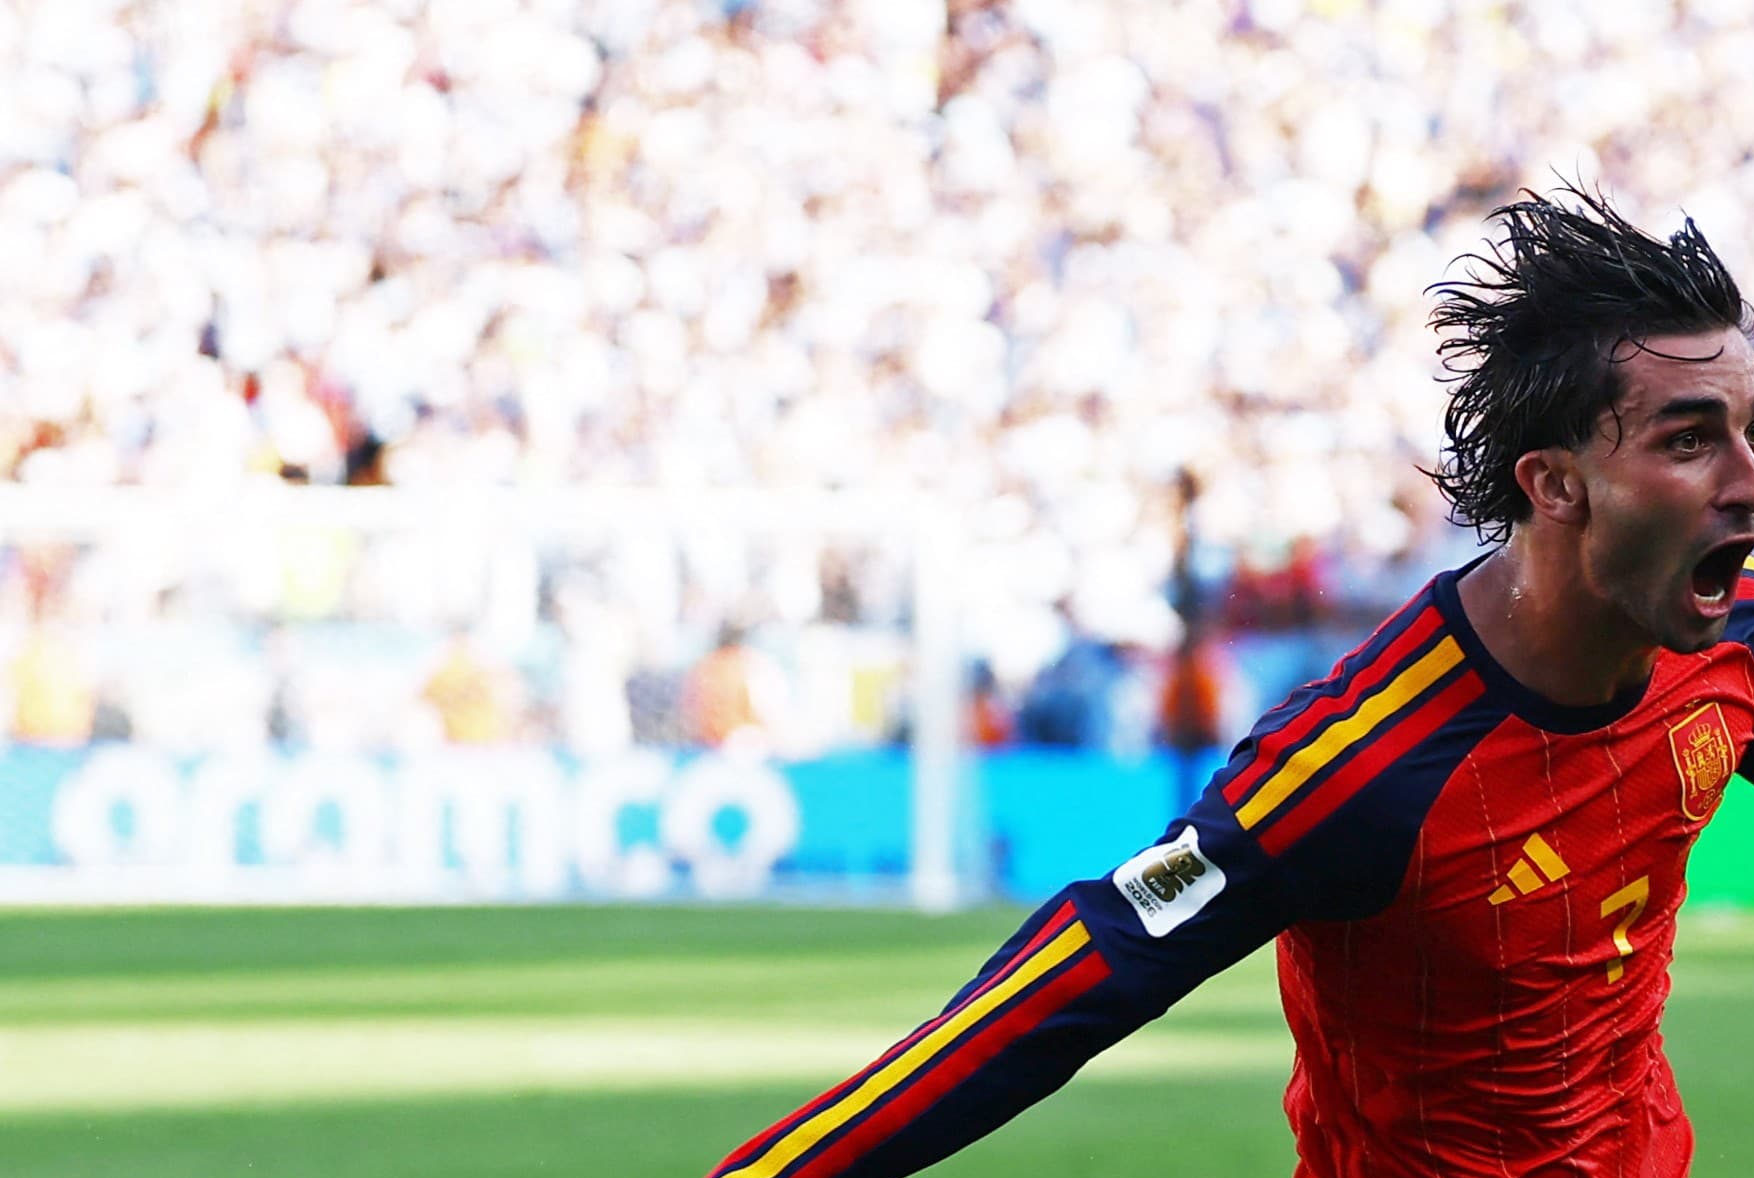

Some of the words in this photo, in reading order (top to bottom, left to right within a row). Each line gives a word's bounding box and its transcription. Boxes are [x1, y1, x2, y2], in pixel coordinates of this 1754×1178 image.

[1125, 880, 1157, 917] 2026
[1149, 877, 1166, 895] FIFA
[1600, 875, 1649, 985] 7
